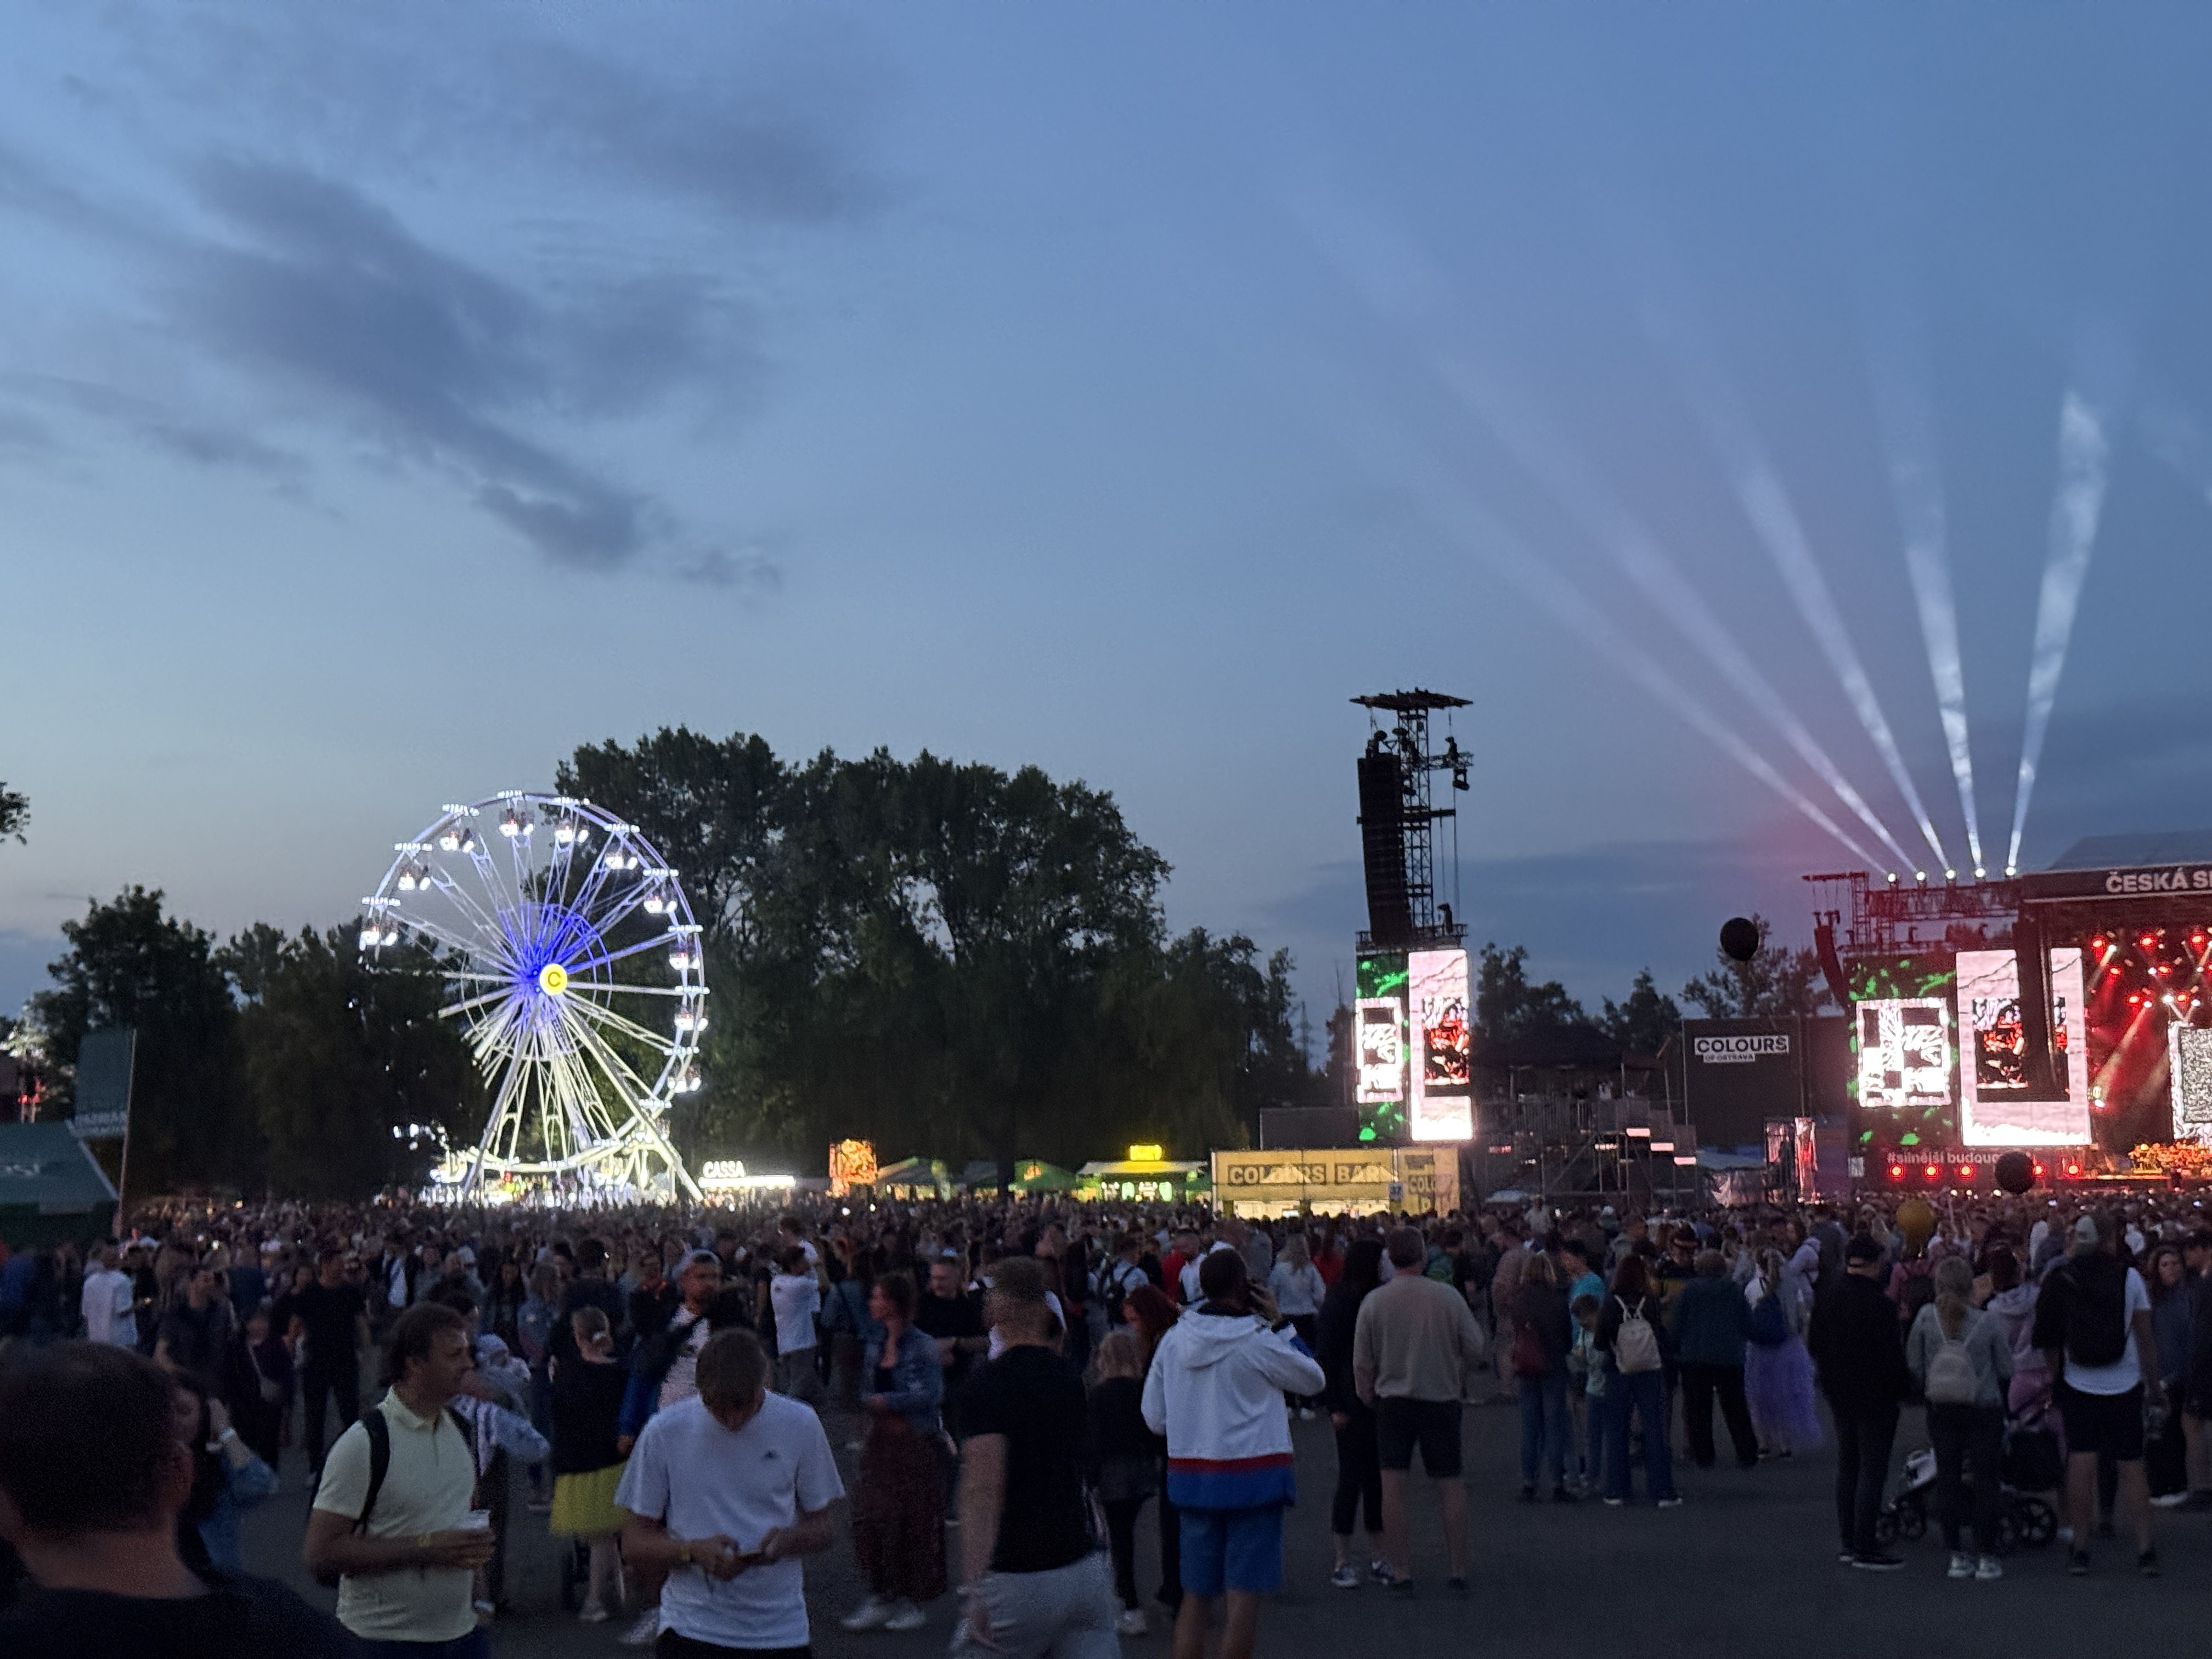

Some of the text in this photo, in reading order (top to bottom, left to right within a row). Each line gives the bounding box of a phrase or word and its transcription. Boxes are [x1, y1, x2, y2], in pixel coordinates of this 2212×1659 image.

[2106, 867, 2188, 893] ČESKÁ
[1697, 1037, 1787, 1053] COLOURS
[702, 1160, 745, 1178] CASSA
